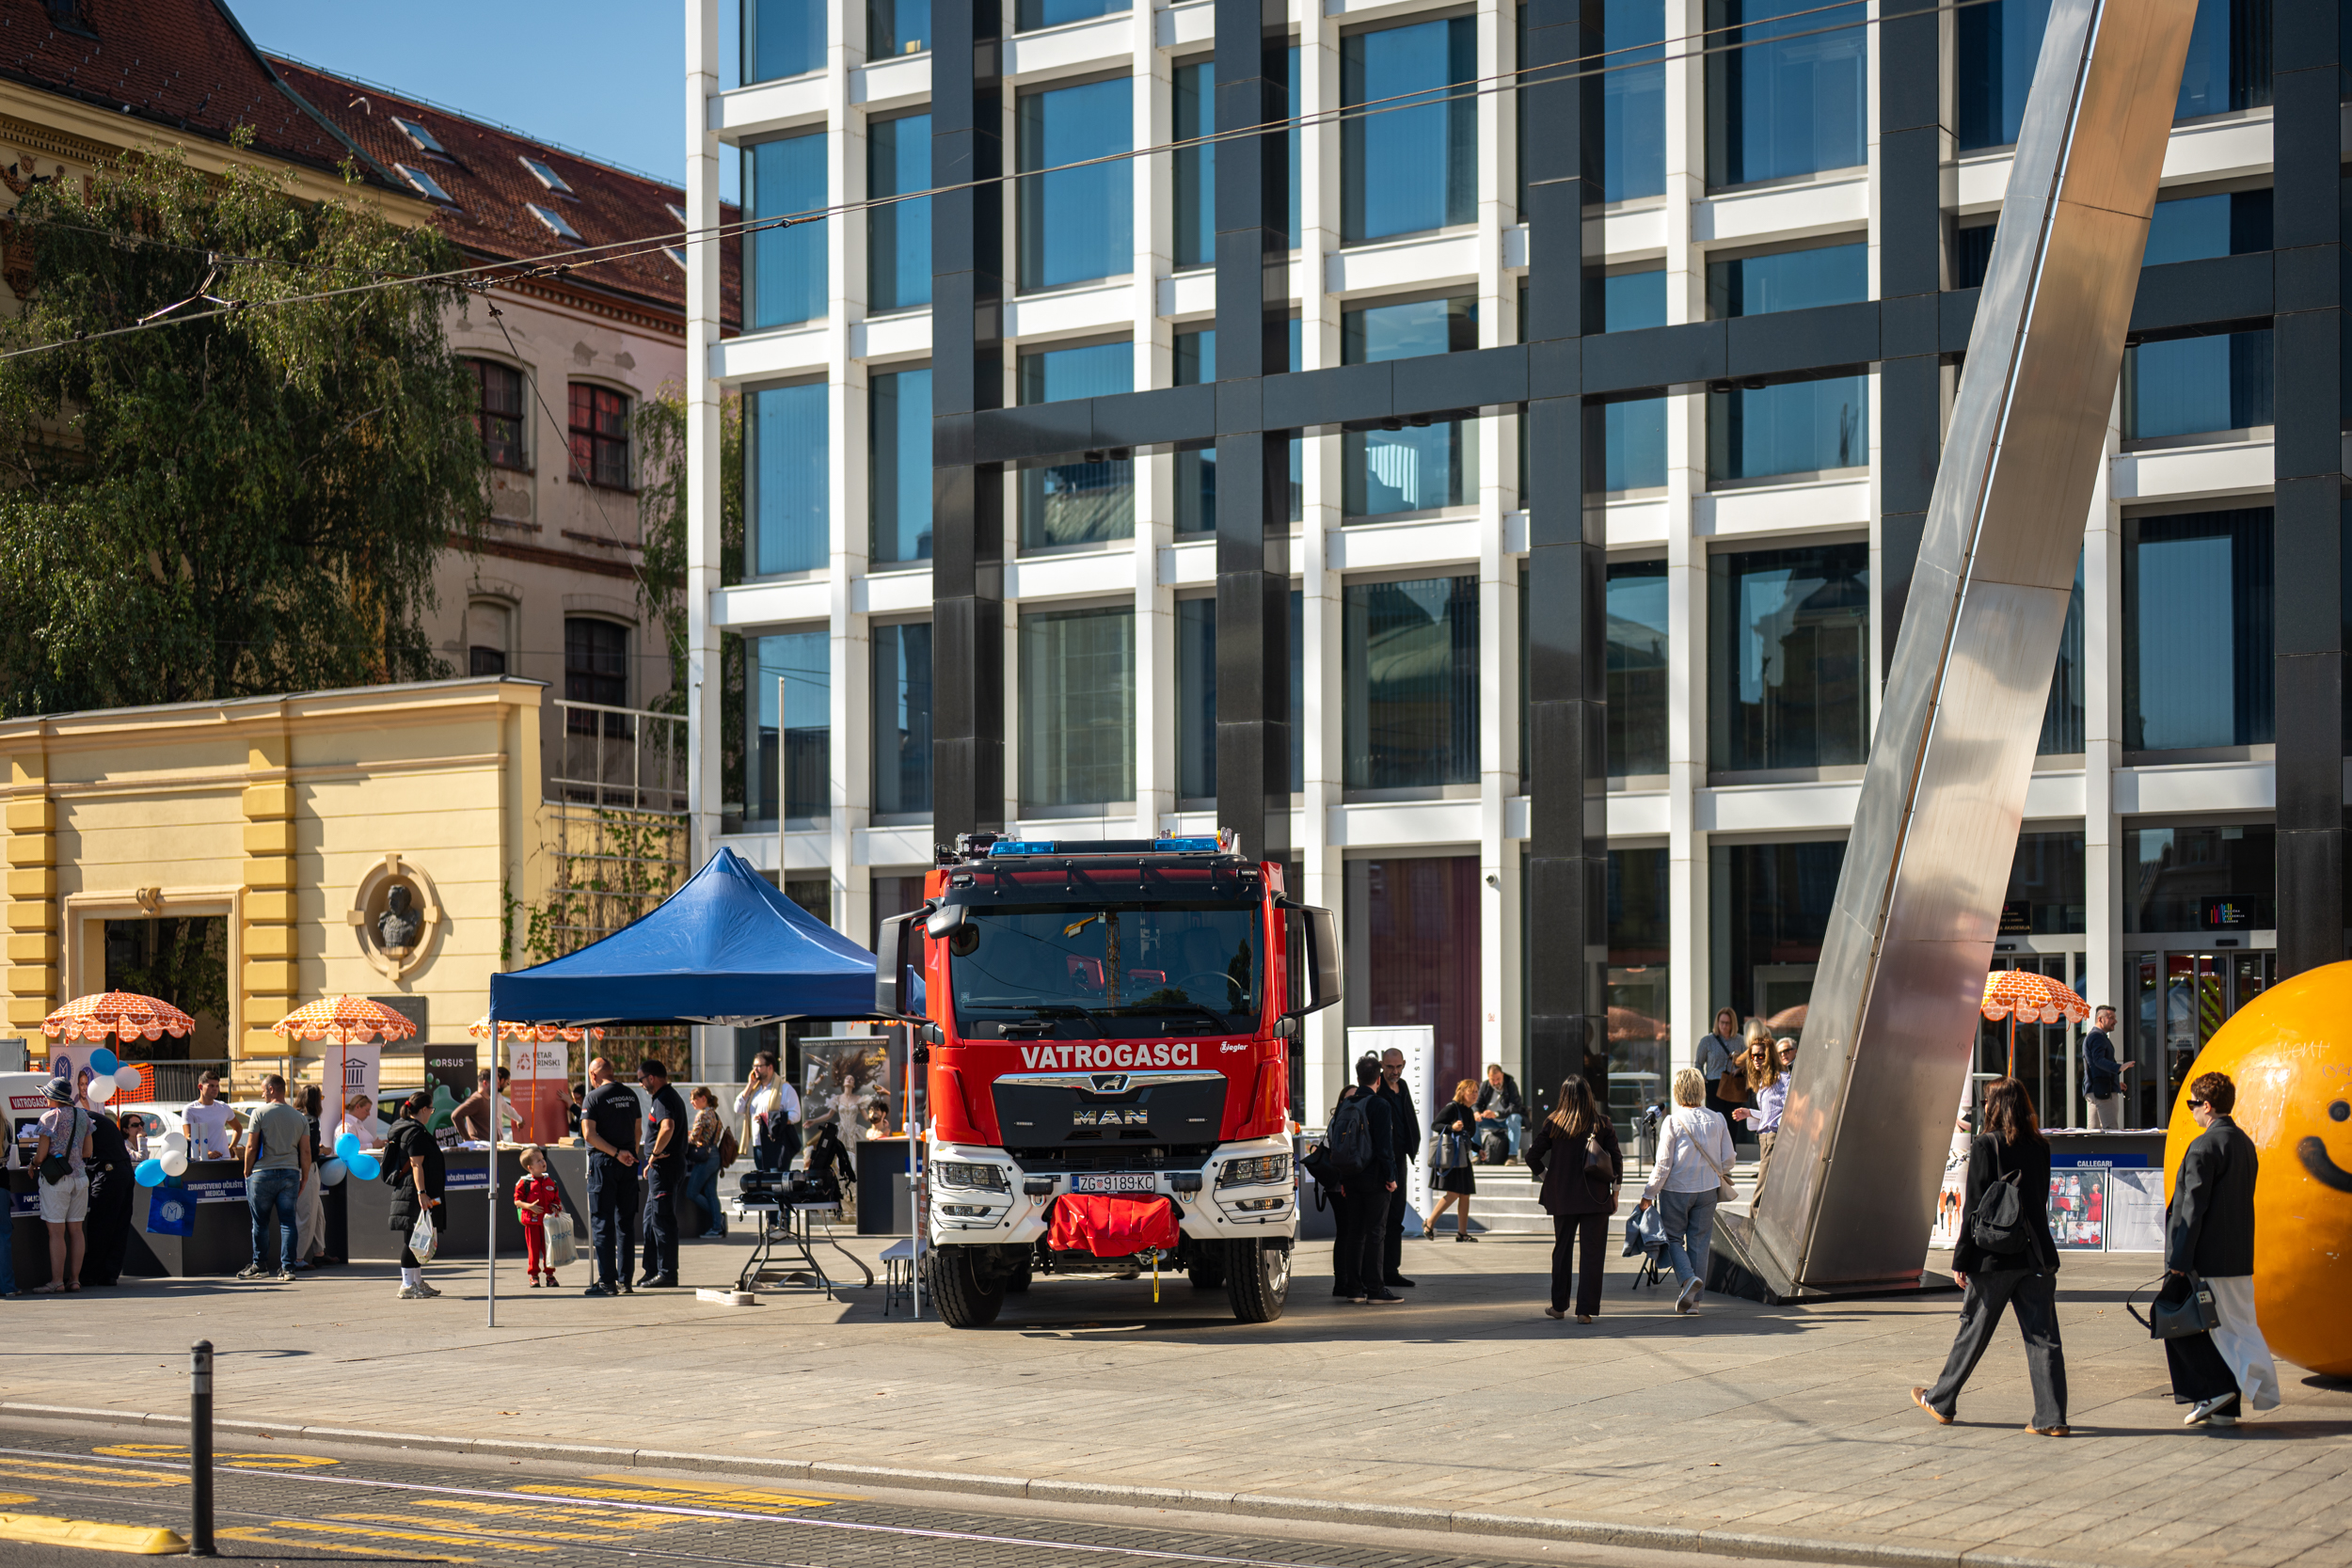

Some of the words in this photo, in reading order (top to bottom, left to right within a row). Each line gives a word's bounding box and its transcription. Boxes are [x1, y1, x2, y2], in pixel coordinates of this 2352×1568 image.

[1220, 1041, 1248, 1053] Ziegler
[1021, 1043, 1198, 1069] VATROGASCI
[436, 1058, 464, 1068] ORSUS
[11, 1097, 49, 1108] VATROGASC
[1073, 1109, 1148, 1125] MAN
[187, 1182, 222, 1191] ZDRAVSTVENO
[223, 1180, 244, 1188] UČILIŠTE
[1080, 1178, 1096, 1190] ZG
